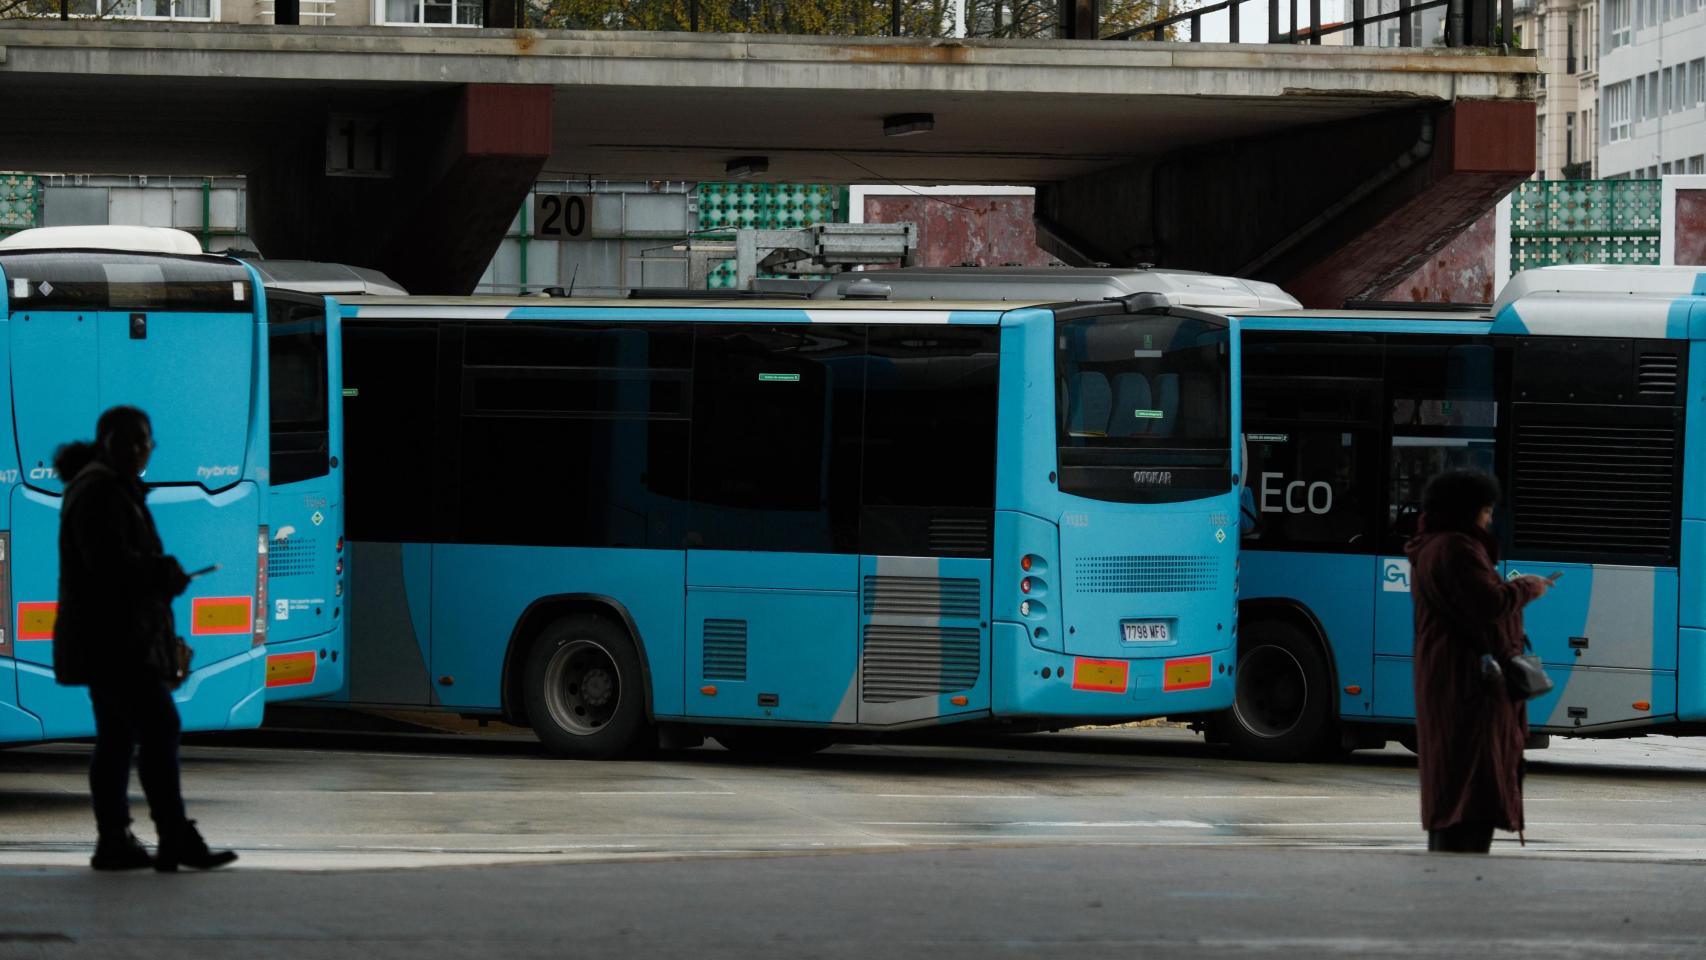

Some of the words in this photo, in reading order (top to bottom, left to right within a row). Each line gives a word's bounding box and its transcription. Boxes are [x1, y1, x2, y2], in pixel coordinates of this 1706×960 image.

[339, 120, 382, 171] 11
[541, 195, 586, 236] 20
[197, 465, 239, 480] hybrid
[1133, 471, 1173, 485] OTOKAR
[1261, 471, 1332, 515] Eco
[1126, 624, 1148, 640] 7798
